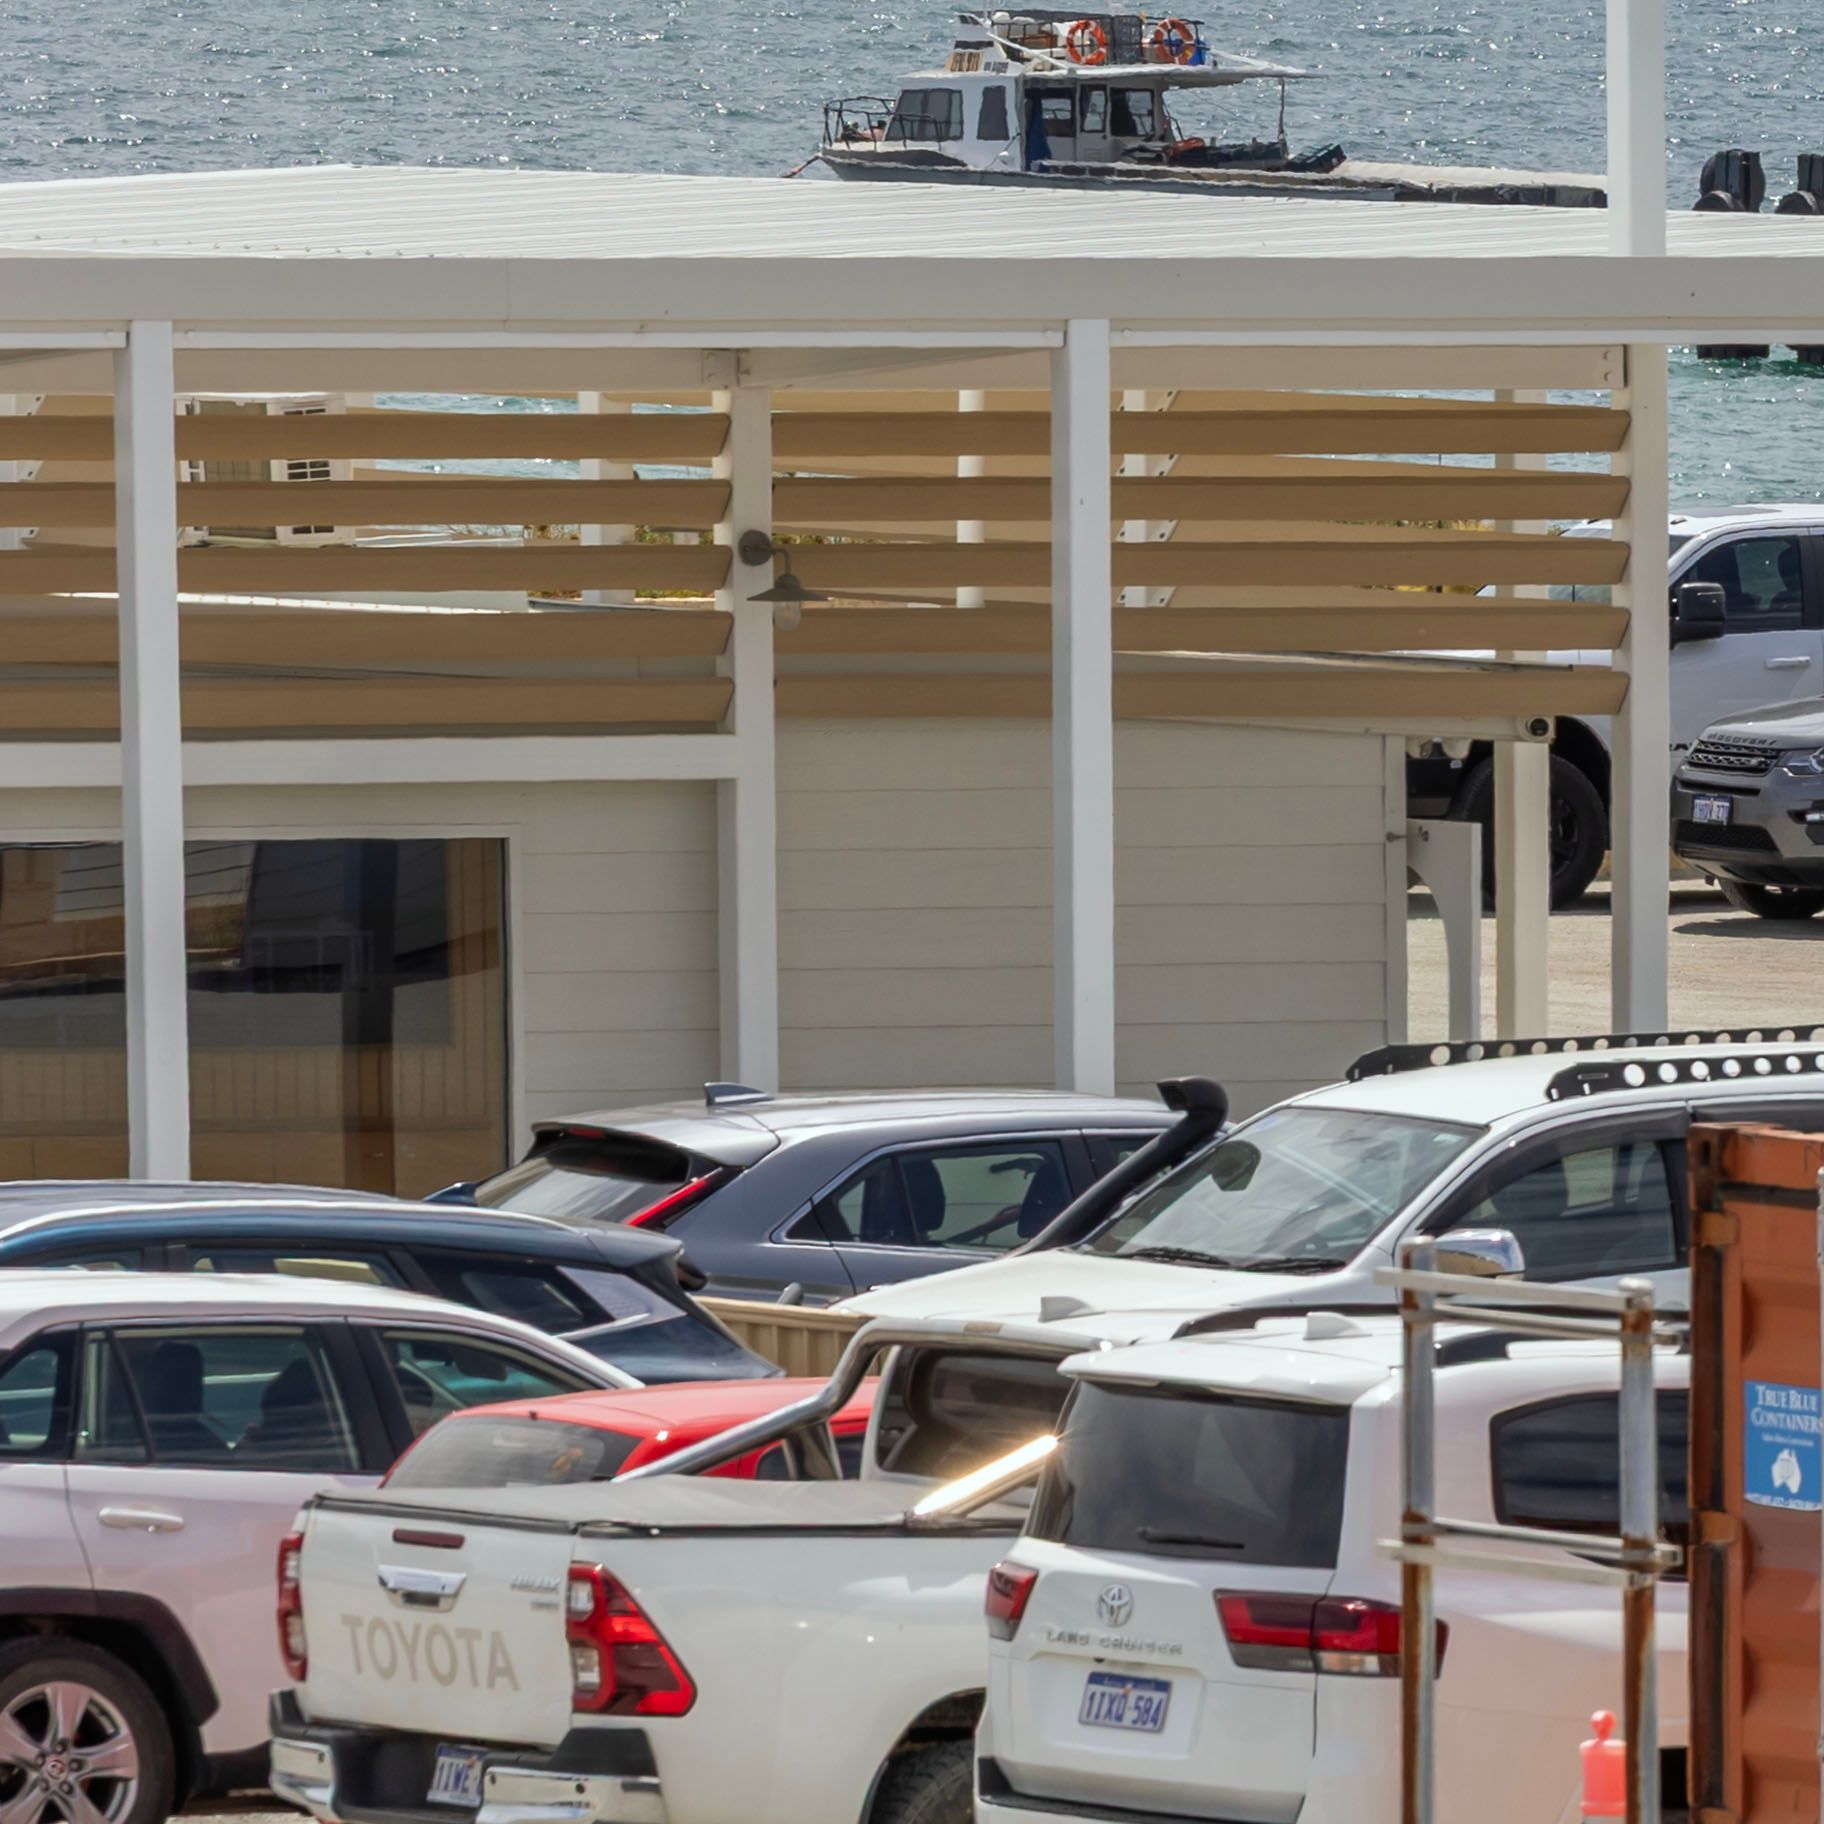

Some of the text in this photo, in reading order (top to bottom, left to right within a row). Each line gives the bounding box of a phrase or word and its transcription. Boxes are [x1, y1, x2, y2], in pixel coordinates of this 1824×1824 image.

[1755, 1385, 1818, 1412] TRUE BLUE
[340, 1613, 521, 1692] TOYOTA
